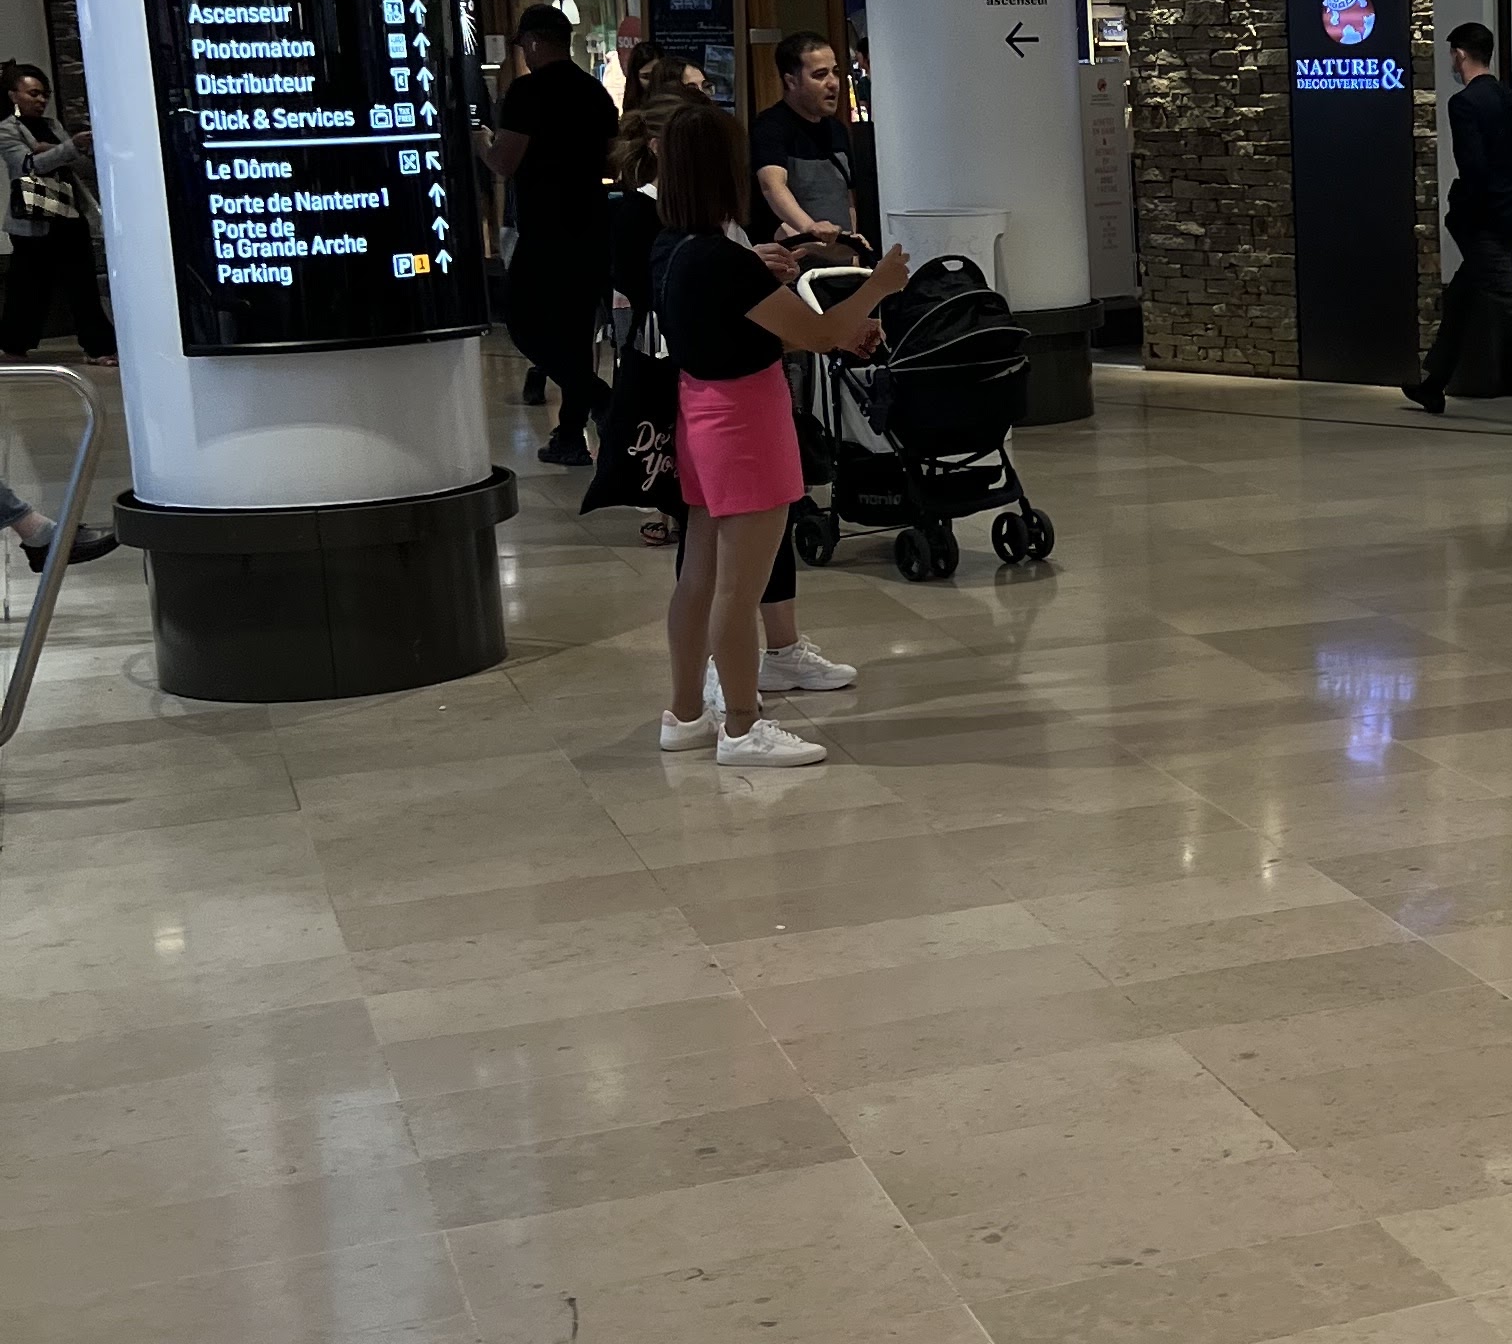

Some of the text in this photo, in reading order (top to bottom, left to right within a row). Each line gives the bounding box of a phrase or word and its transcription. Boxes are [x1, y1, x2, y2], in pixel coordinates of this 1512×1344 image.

[188, 3, 292, 25] Ascenseur
[191, 37, 316, 60] Photomaton
[195, 72, 316, 95] Distributeur
[1295, 58, 1405, 90] NATURE &
[1296, 77, 1380, 90] DECOUVERTES
[200, 106, 356, 131] Click & Services
[205, 158, 293, 181] Le Dôme
[209, 187, 390, 215] Porte de Nanterre 1
[212, 217, 295, 239] Porte de
[213, 234, 368, 259] la Grande Arche
[217, 262, 294, 286] Parking
